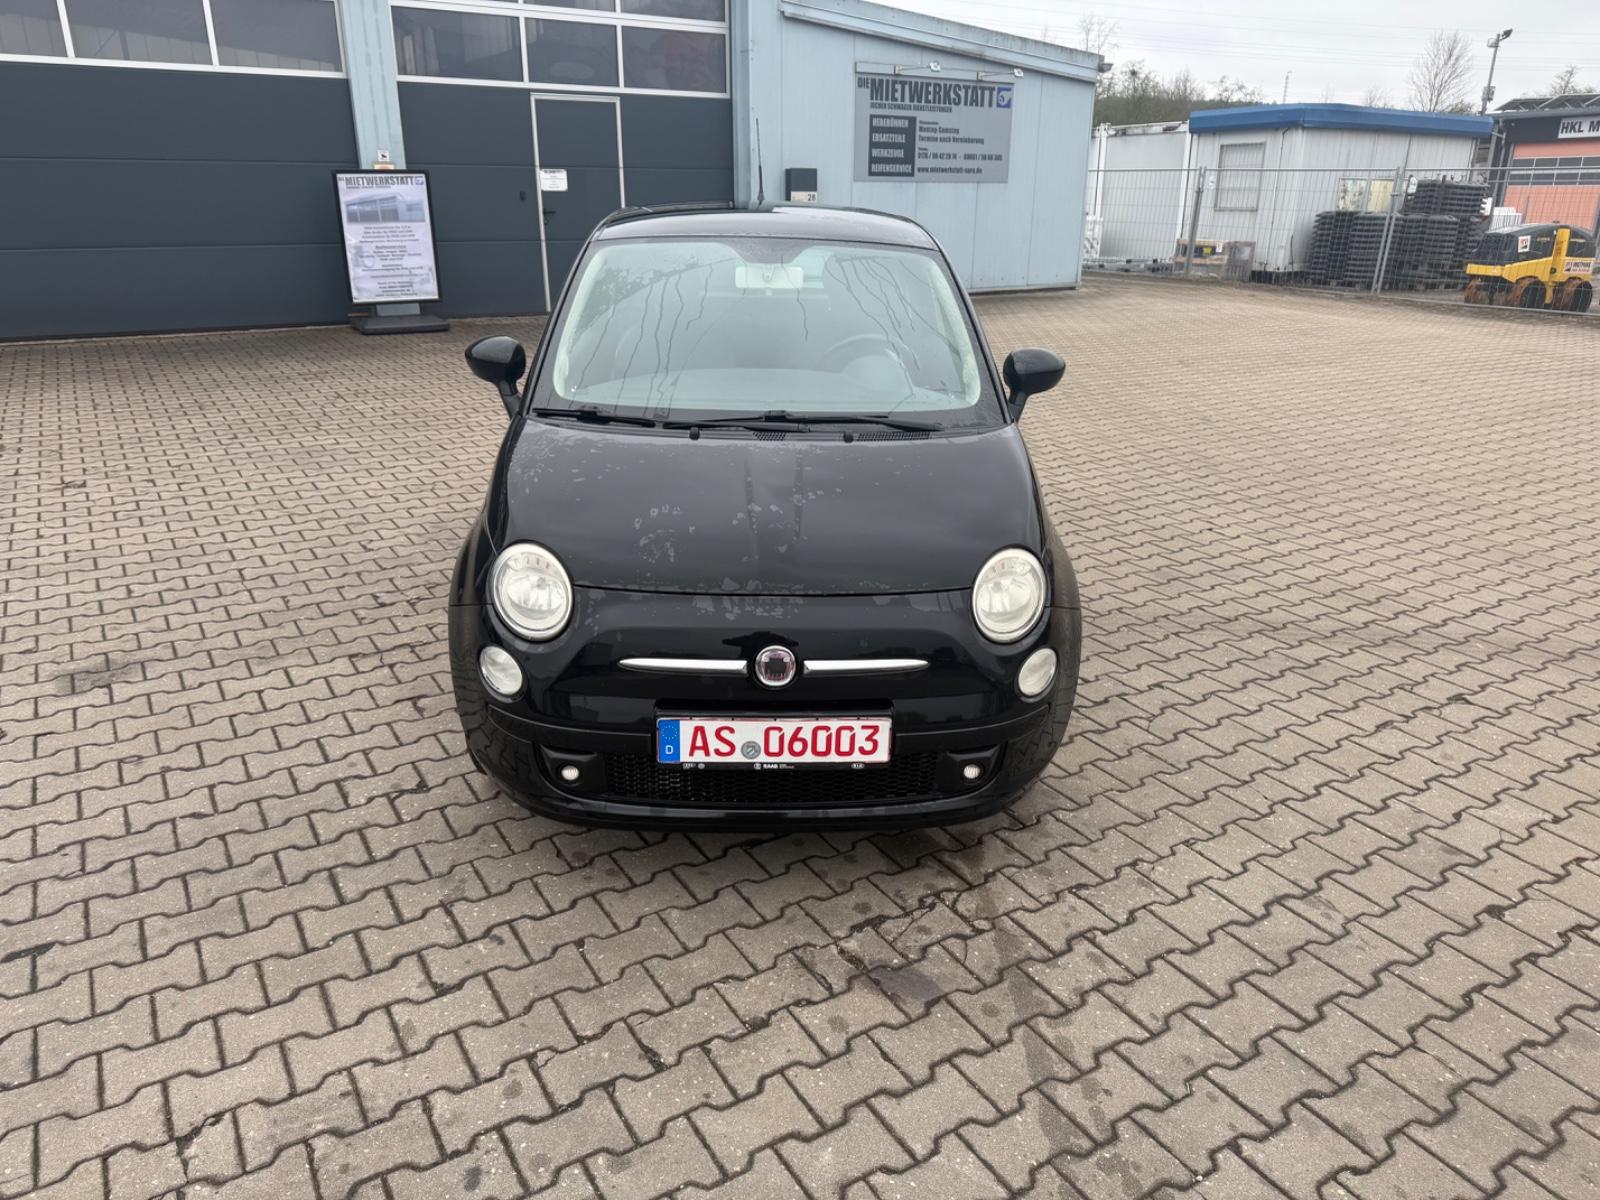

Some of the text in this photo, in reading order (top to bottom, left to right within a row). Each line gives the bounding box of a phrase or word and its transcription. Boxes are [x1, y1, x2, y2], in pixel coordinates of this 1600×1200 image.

[857, 77, 995, 108] DIE MIETWERKSTATT
[1560, 120, 1584, 134] HKL
[344, 175, 413, 186] MIETWERKSTATT
[665, 725, 880, 758] D AS 06003
